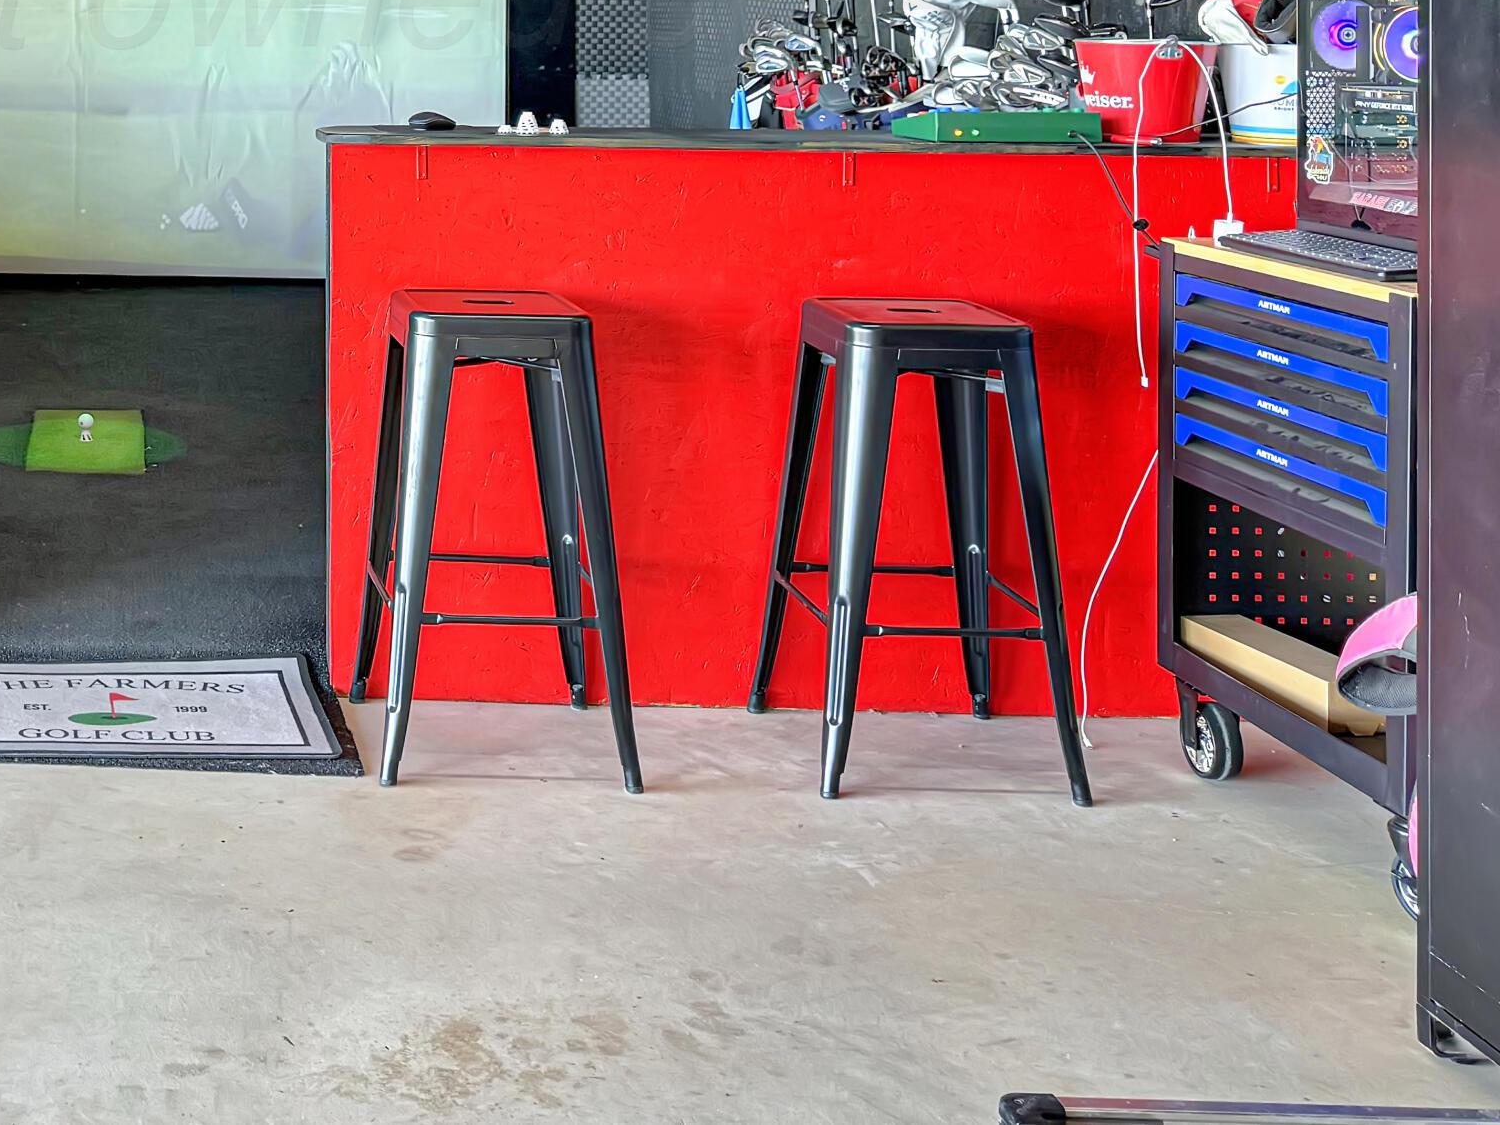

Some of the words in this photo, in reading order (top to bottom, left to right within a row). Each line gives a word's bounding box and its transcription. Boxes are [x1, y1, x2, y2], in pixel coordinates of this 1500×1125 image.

[63, 676, 246, 694] FARMERS
[23, 702, 52, 713] EST.
[18, 727, 113, 741] GOLF
[119, 729, 216, 742] CLUB
